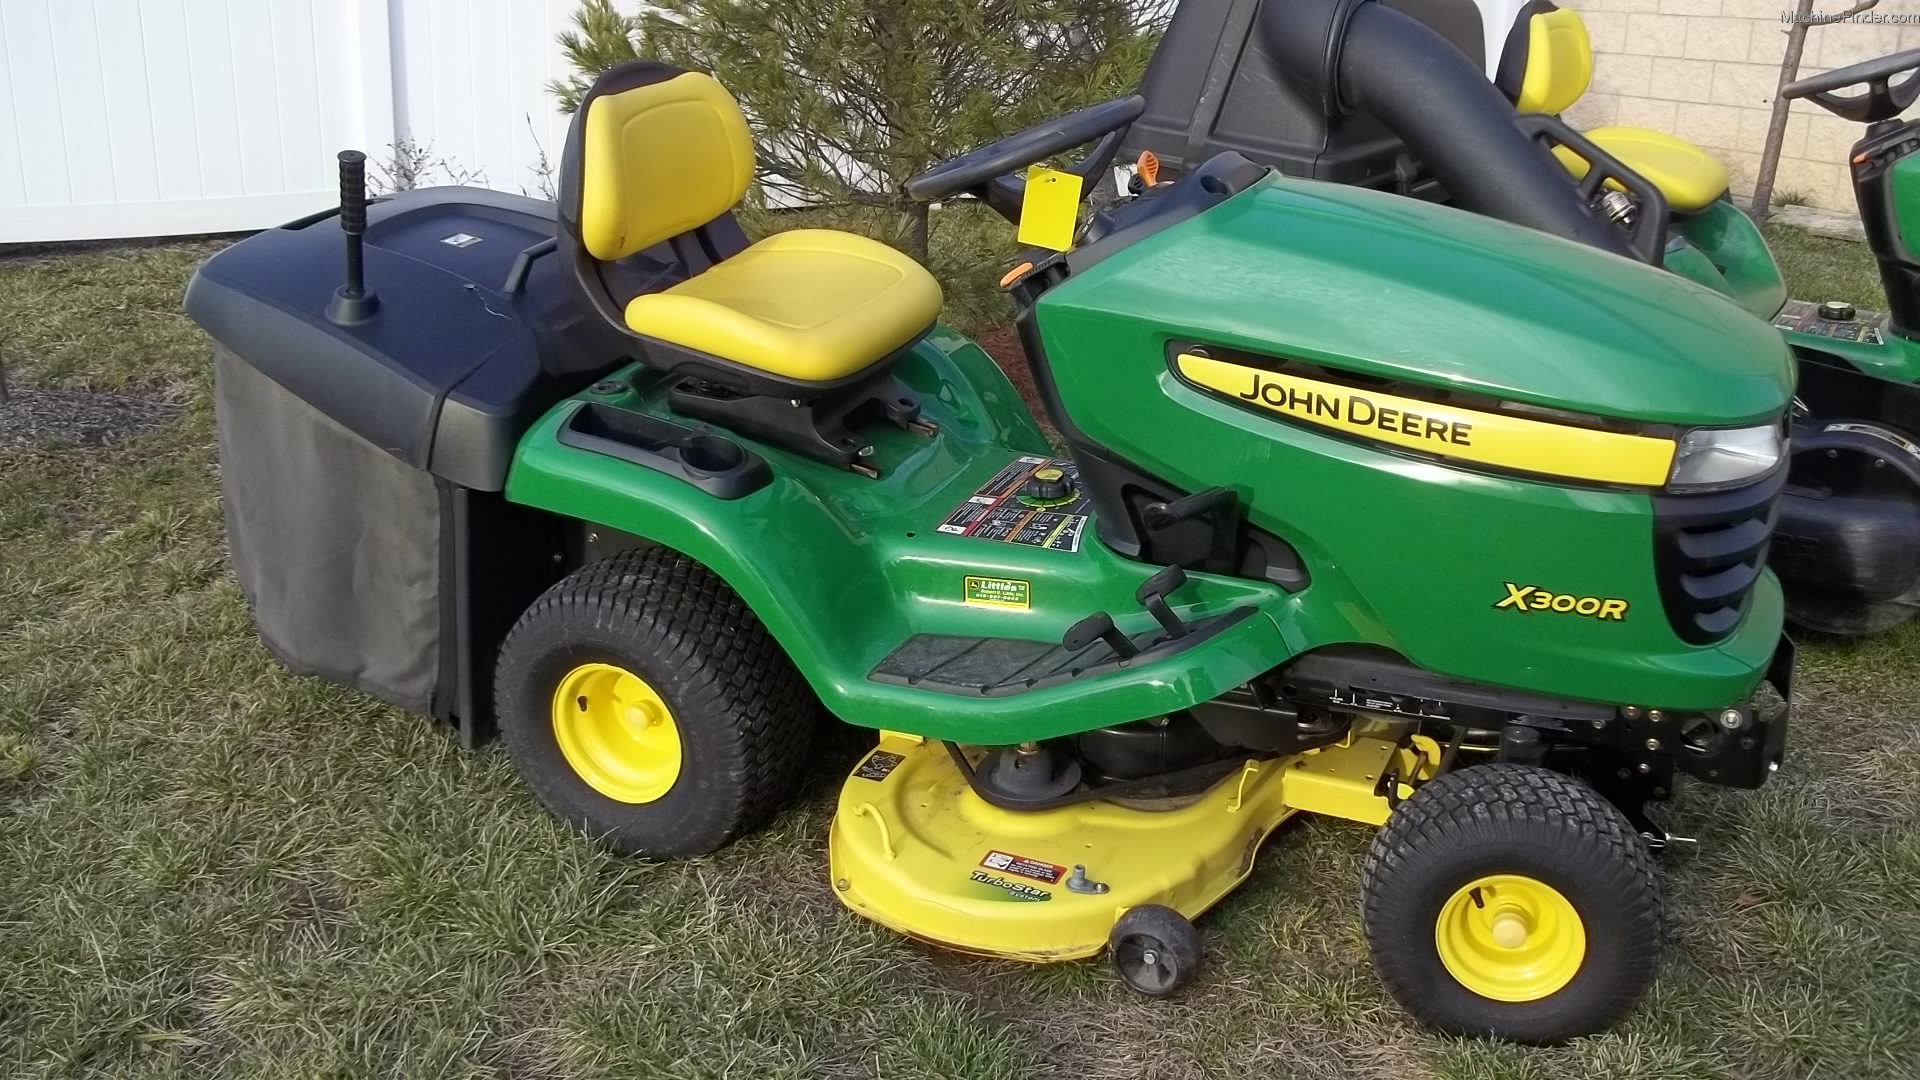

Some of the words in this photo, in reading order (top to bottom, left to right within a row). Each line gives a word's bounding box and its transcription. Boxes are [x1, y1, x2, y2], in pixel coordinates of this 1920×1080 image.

[1239, 374, 1340, 420] JOHN
[1348, 395, 1473, 447] DEERE
[1492, 581, 1629, 621] X300R
[970, 870, 1051, 897] TurboStar
